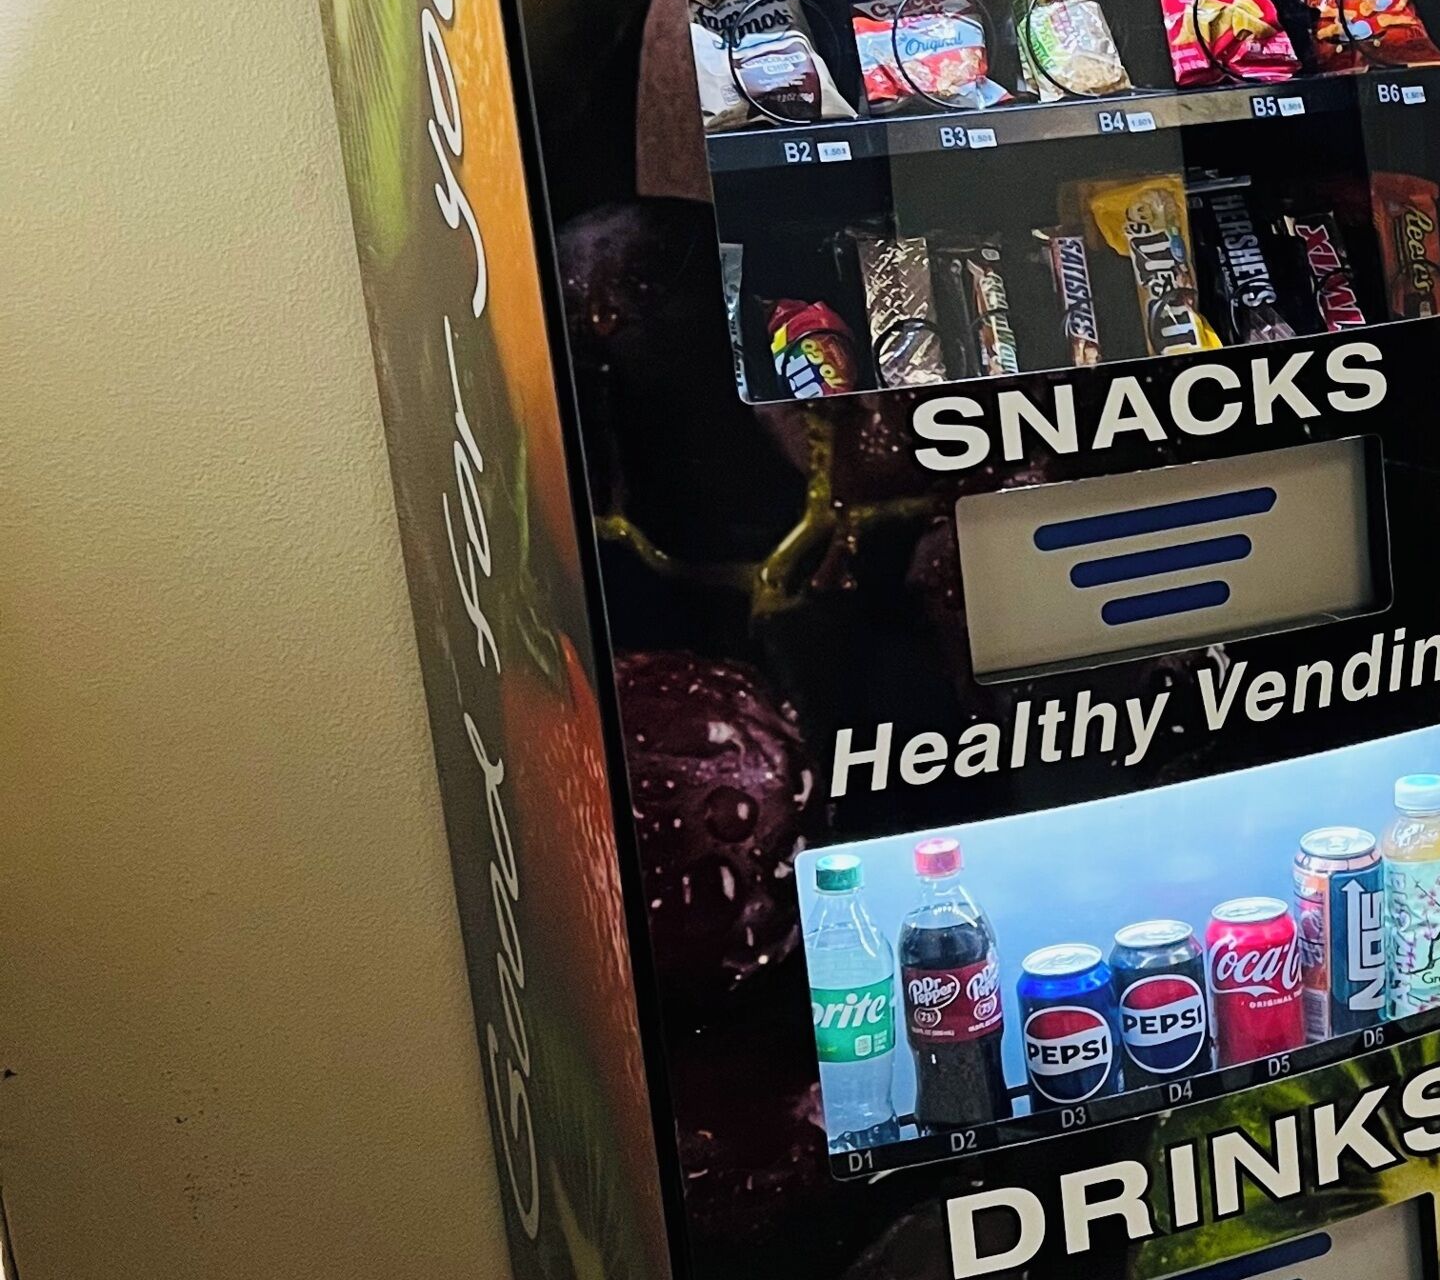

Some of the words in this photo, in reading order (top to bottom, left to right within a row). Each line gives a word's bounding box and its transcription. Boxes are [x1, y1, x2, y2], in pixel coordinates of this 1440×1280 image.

[905, 32, 963, 57] Original
[1378, 84, 1400, 103] B6
[1252, 96, 1277, 116] B5
[1099, 112, 1125, 132] B4
[940, 127, 967, 148] B3
[785, 142, 812, 163] B2
[912, 342, 1387, 471] SNACKS
[443, 317, 501, 674] for
[830, 691, 1169, 798] Healthy
[463, 711, 541, 1240] Good
[922, 977, 942, 994] Dr
[909, 979, 955, 1007] Pepper
[1249, 995, 1293, 1009] ORIGINAL
[1363, 1027, 1385, 1048] D6
[1027, 1036, 1108, 1065] PEPSI
[1267, 1055, 1291, 1077] D5
[1169, 1080, 1193, 1103] D4
[1061, 1107, 1087, 1129] D3
[951, 1131, 977, 1152] D2
[849, 1149, 875, 1172] D1
